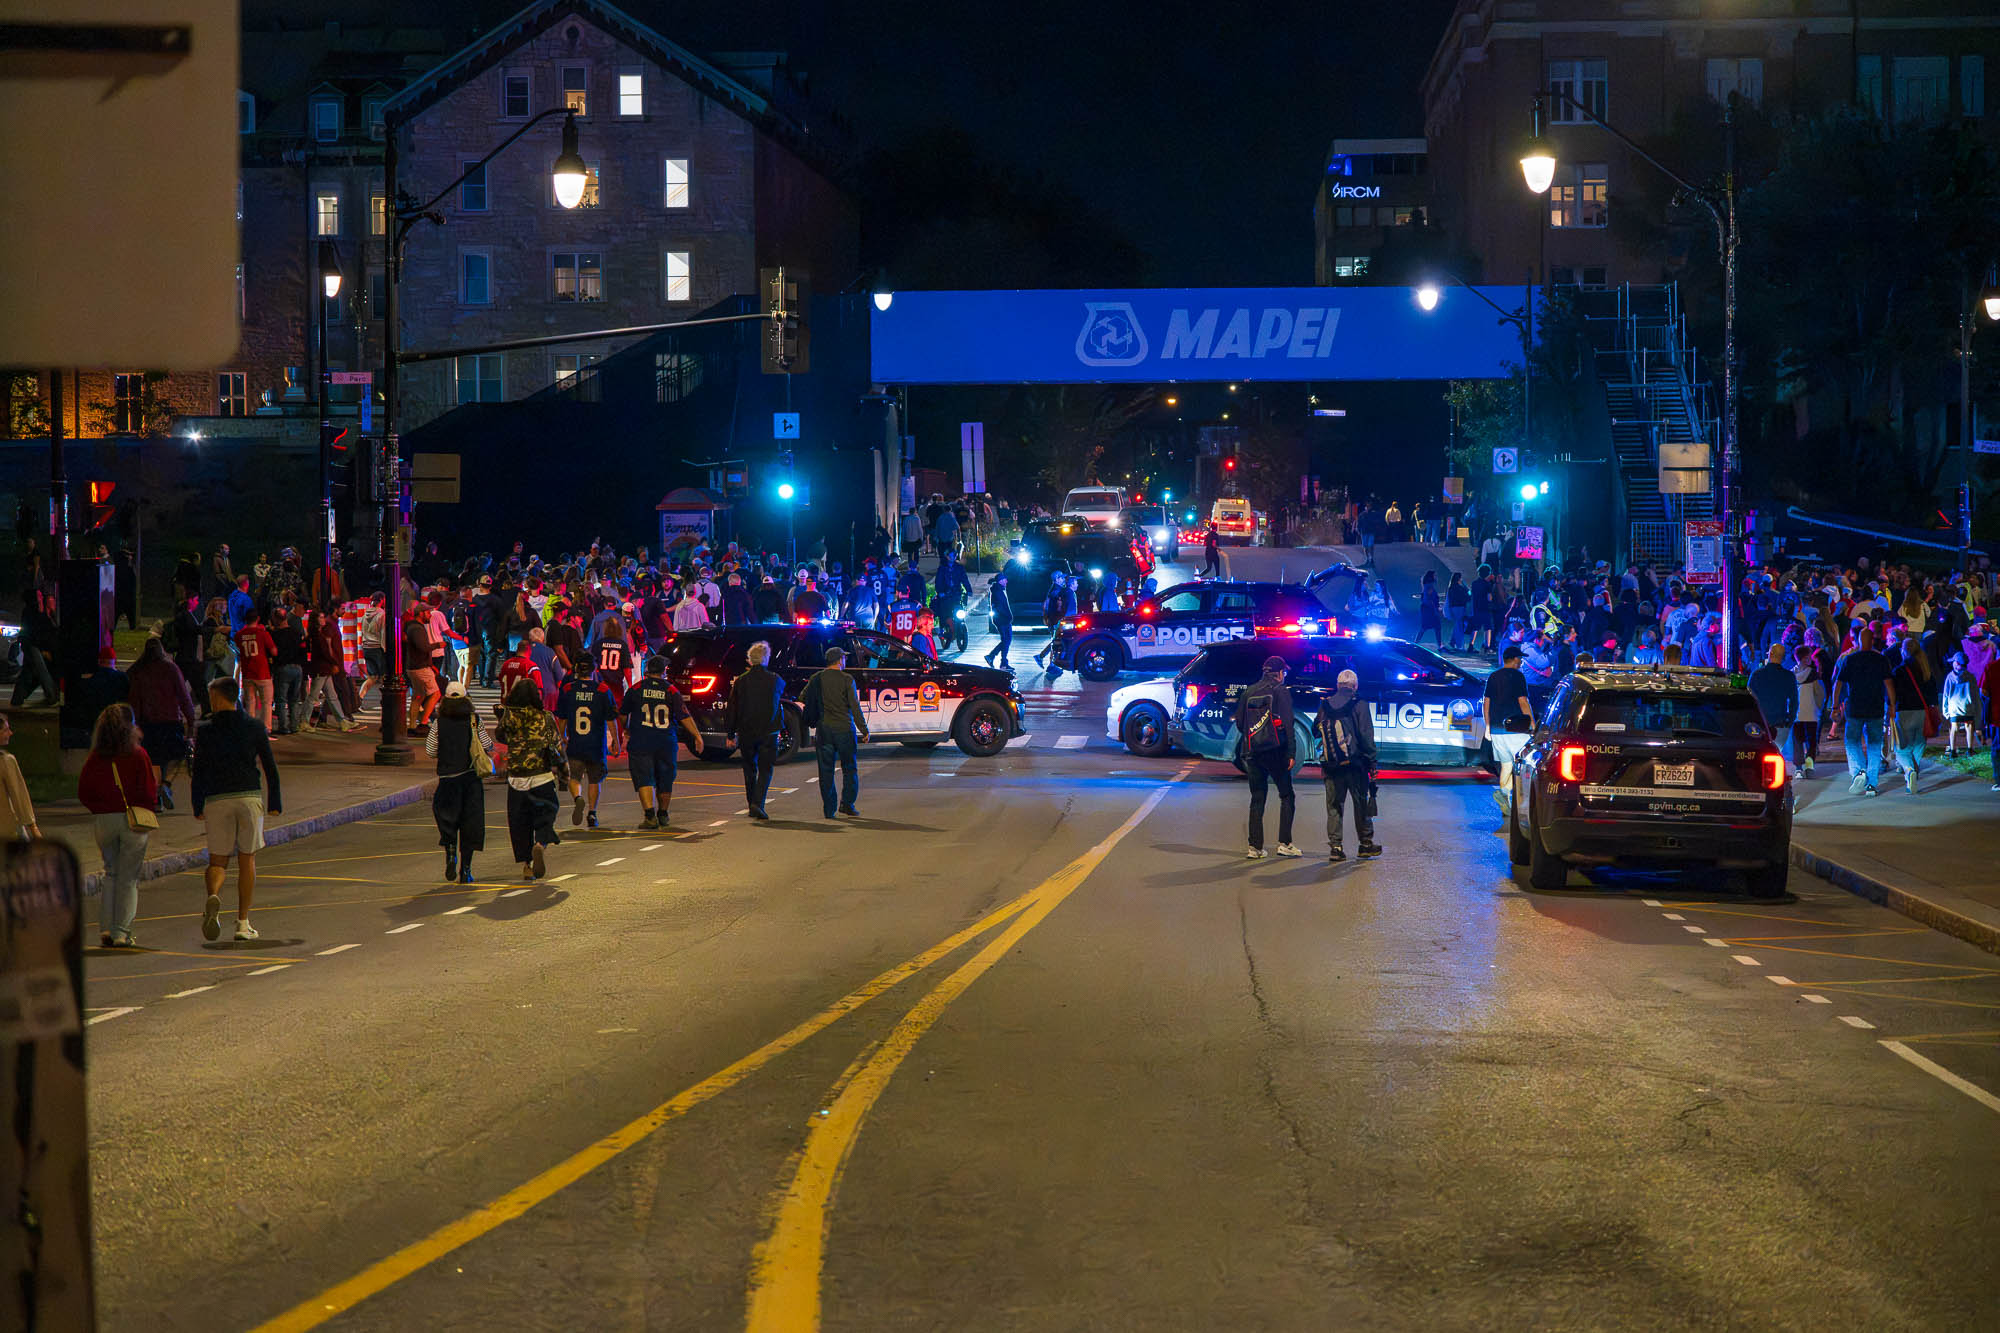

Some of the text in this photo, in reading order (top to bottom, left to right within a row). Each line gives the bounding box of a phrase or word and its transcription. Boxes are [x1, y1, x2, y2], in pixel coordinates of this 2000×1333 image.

[1160, 307, 1342, 359] MAPEI
[873, 580, 882, 595] 8
[896, 612, 913, 630] 86
[241, 640, 259, 657] 10
[600, 649, 620, 670] 10
[857, 688, 917, 712] LICE
[575, 706, 591, 735] 6
[641, 703, 670, 729] 10
[1207, 709, 1223, 718] 911
[1368, 702, 1445, 730] LICE
[1586, 744, 1620, 754] POLICE
[1736, 752, 1756, 760] 20-87
[1655, 769, 1693, 782] FRZ6237
[1648, 803, 1700, 812] spvm.qc.ca
